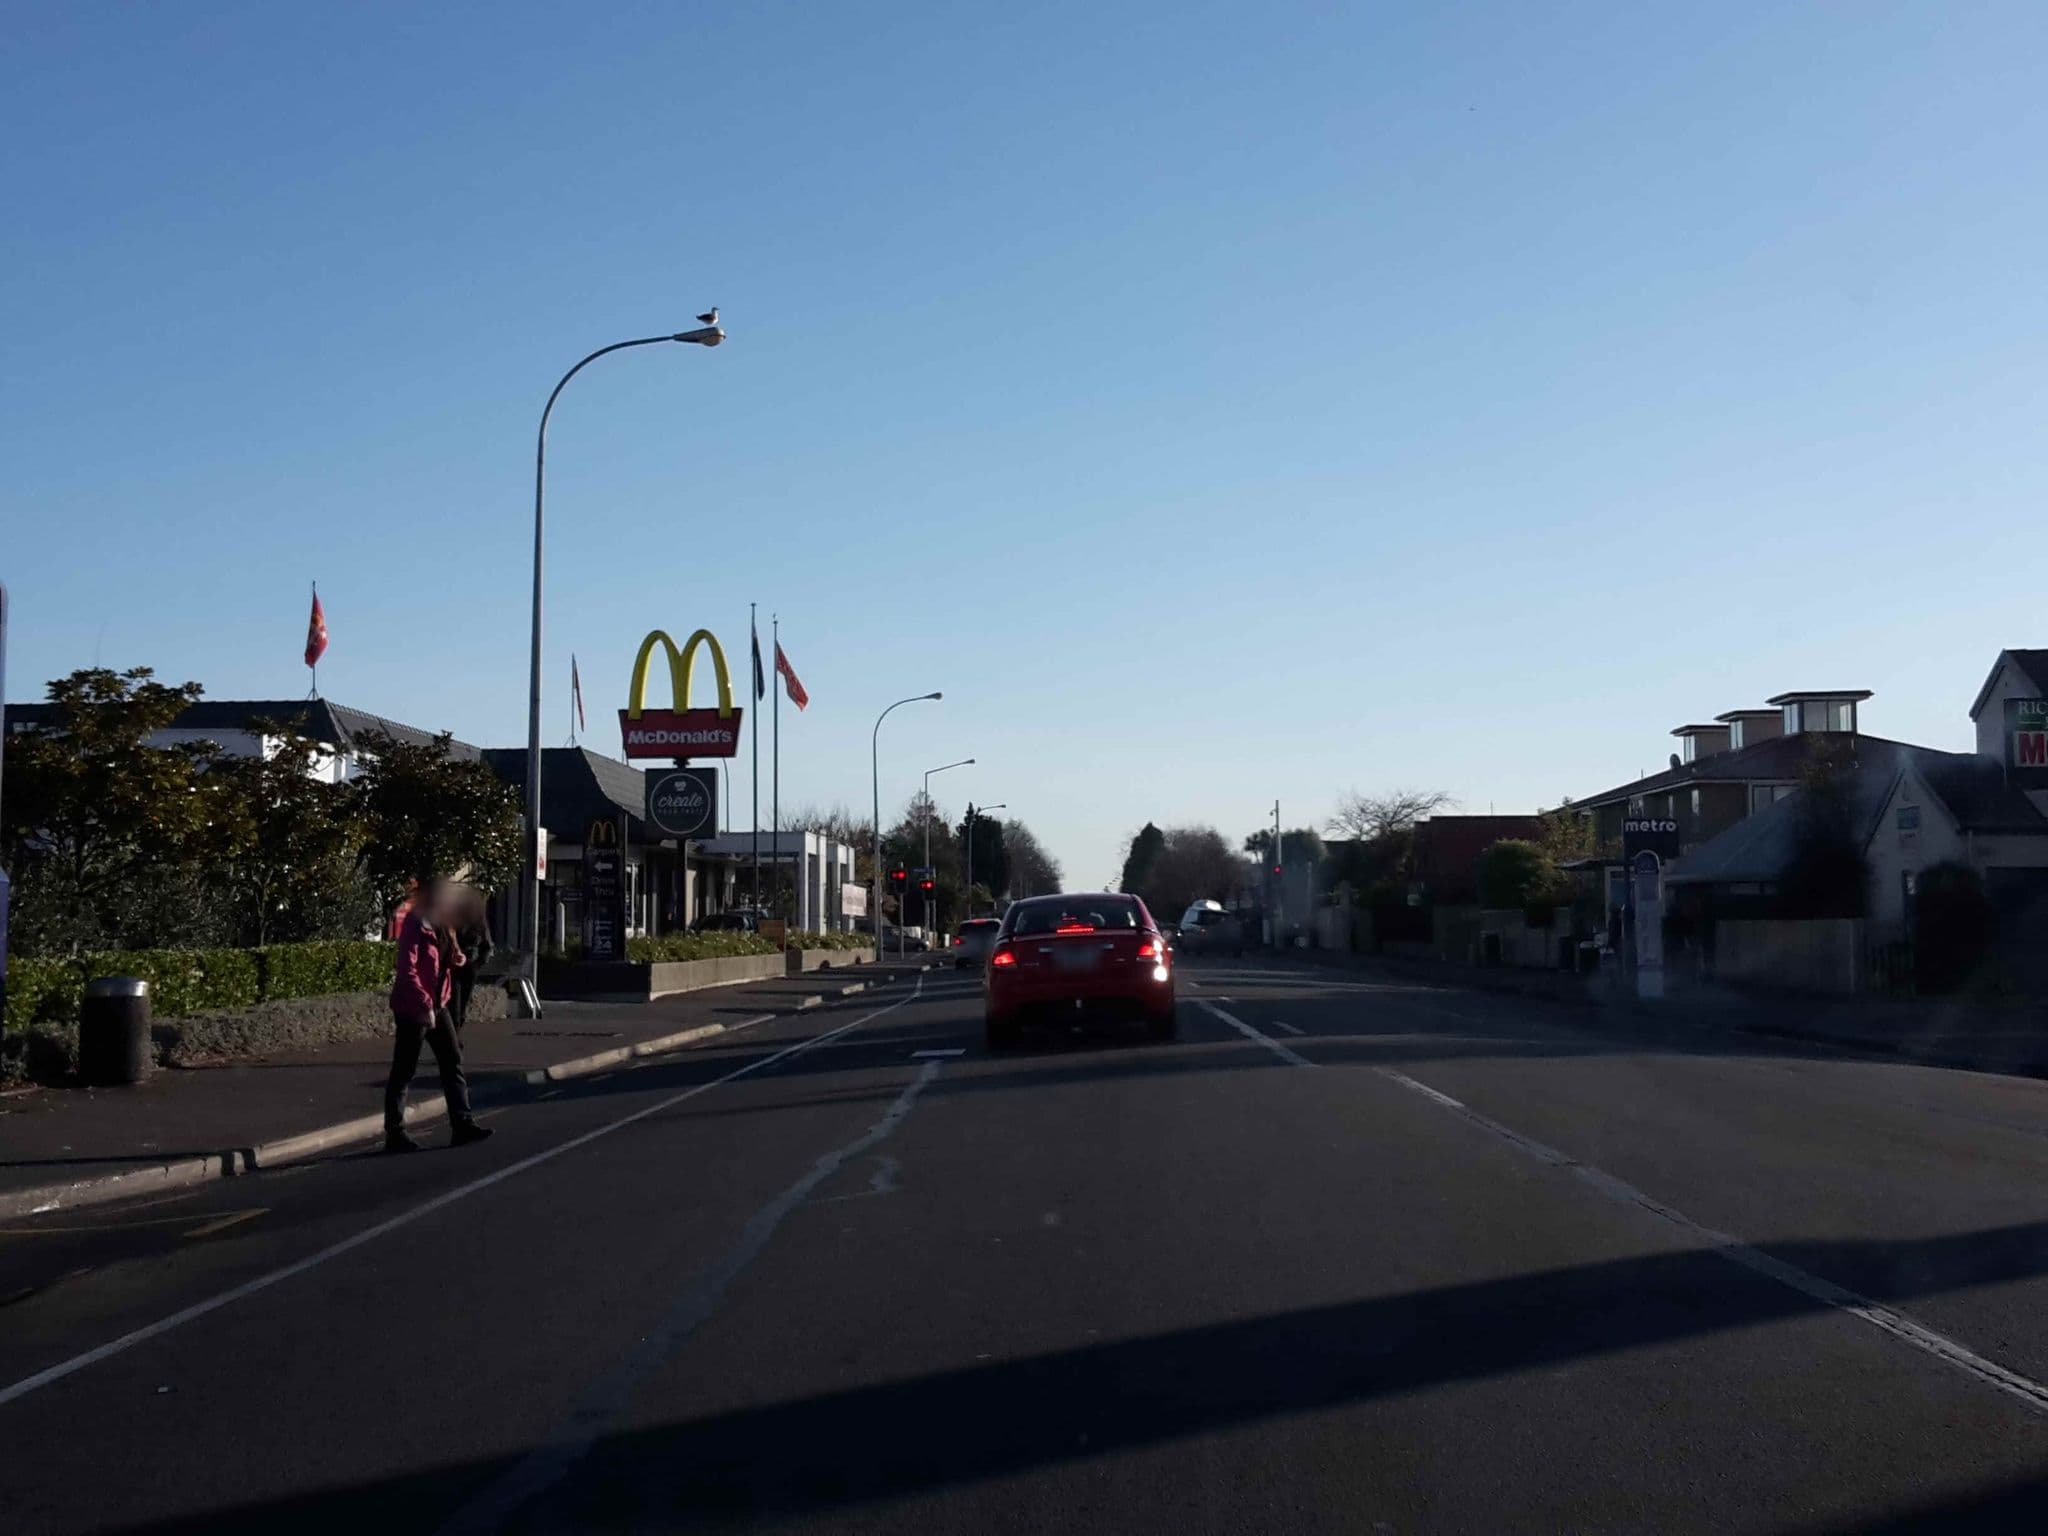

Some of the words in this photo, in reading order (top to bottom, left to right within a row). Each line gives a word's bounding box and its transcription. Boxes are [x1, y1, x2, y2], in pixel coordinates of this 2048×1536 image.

[627, 729, 733, 745] McDonald's
[2018, 734, 2048, 764] M
[657, 792, 704, 808] create
[1624, 820, 1677, 832] metro
